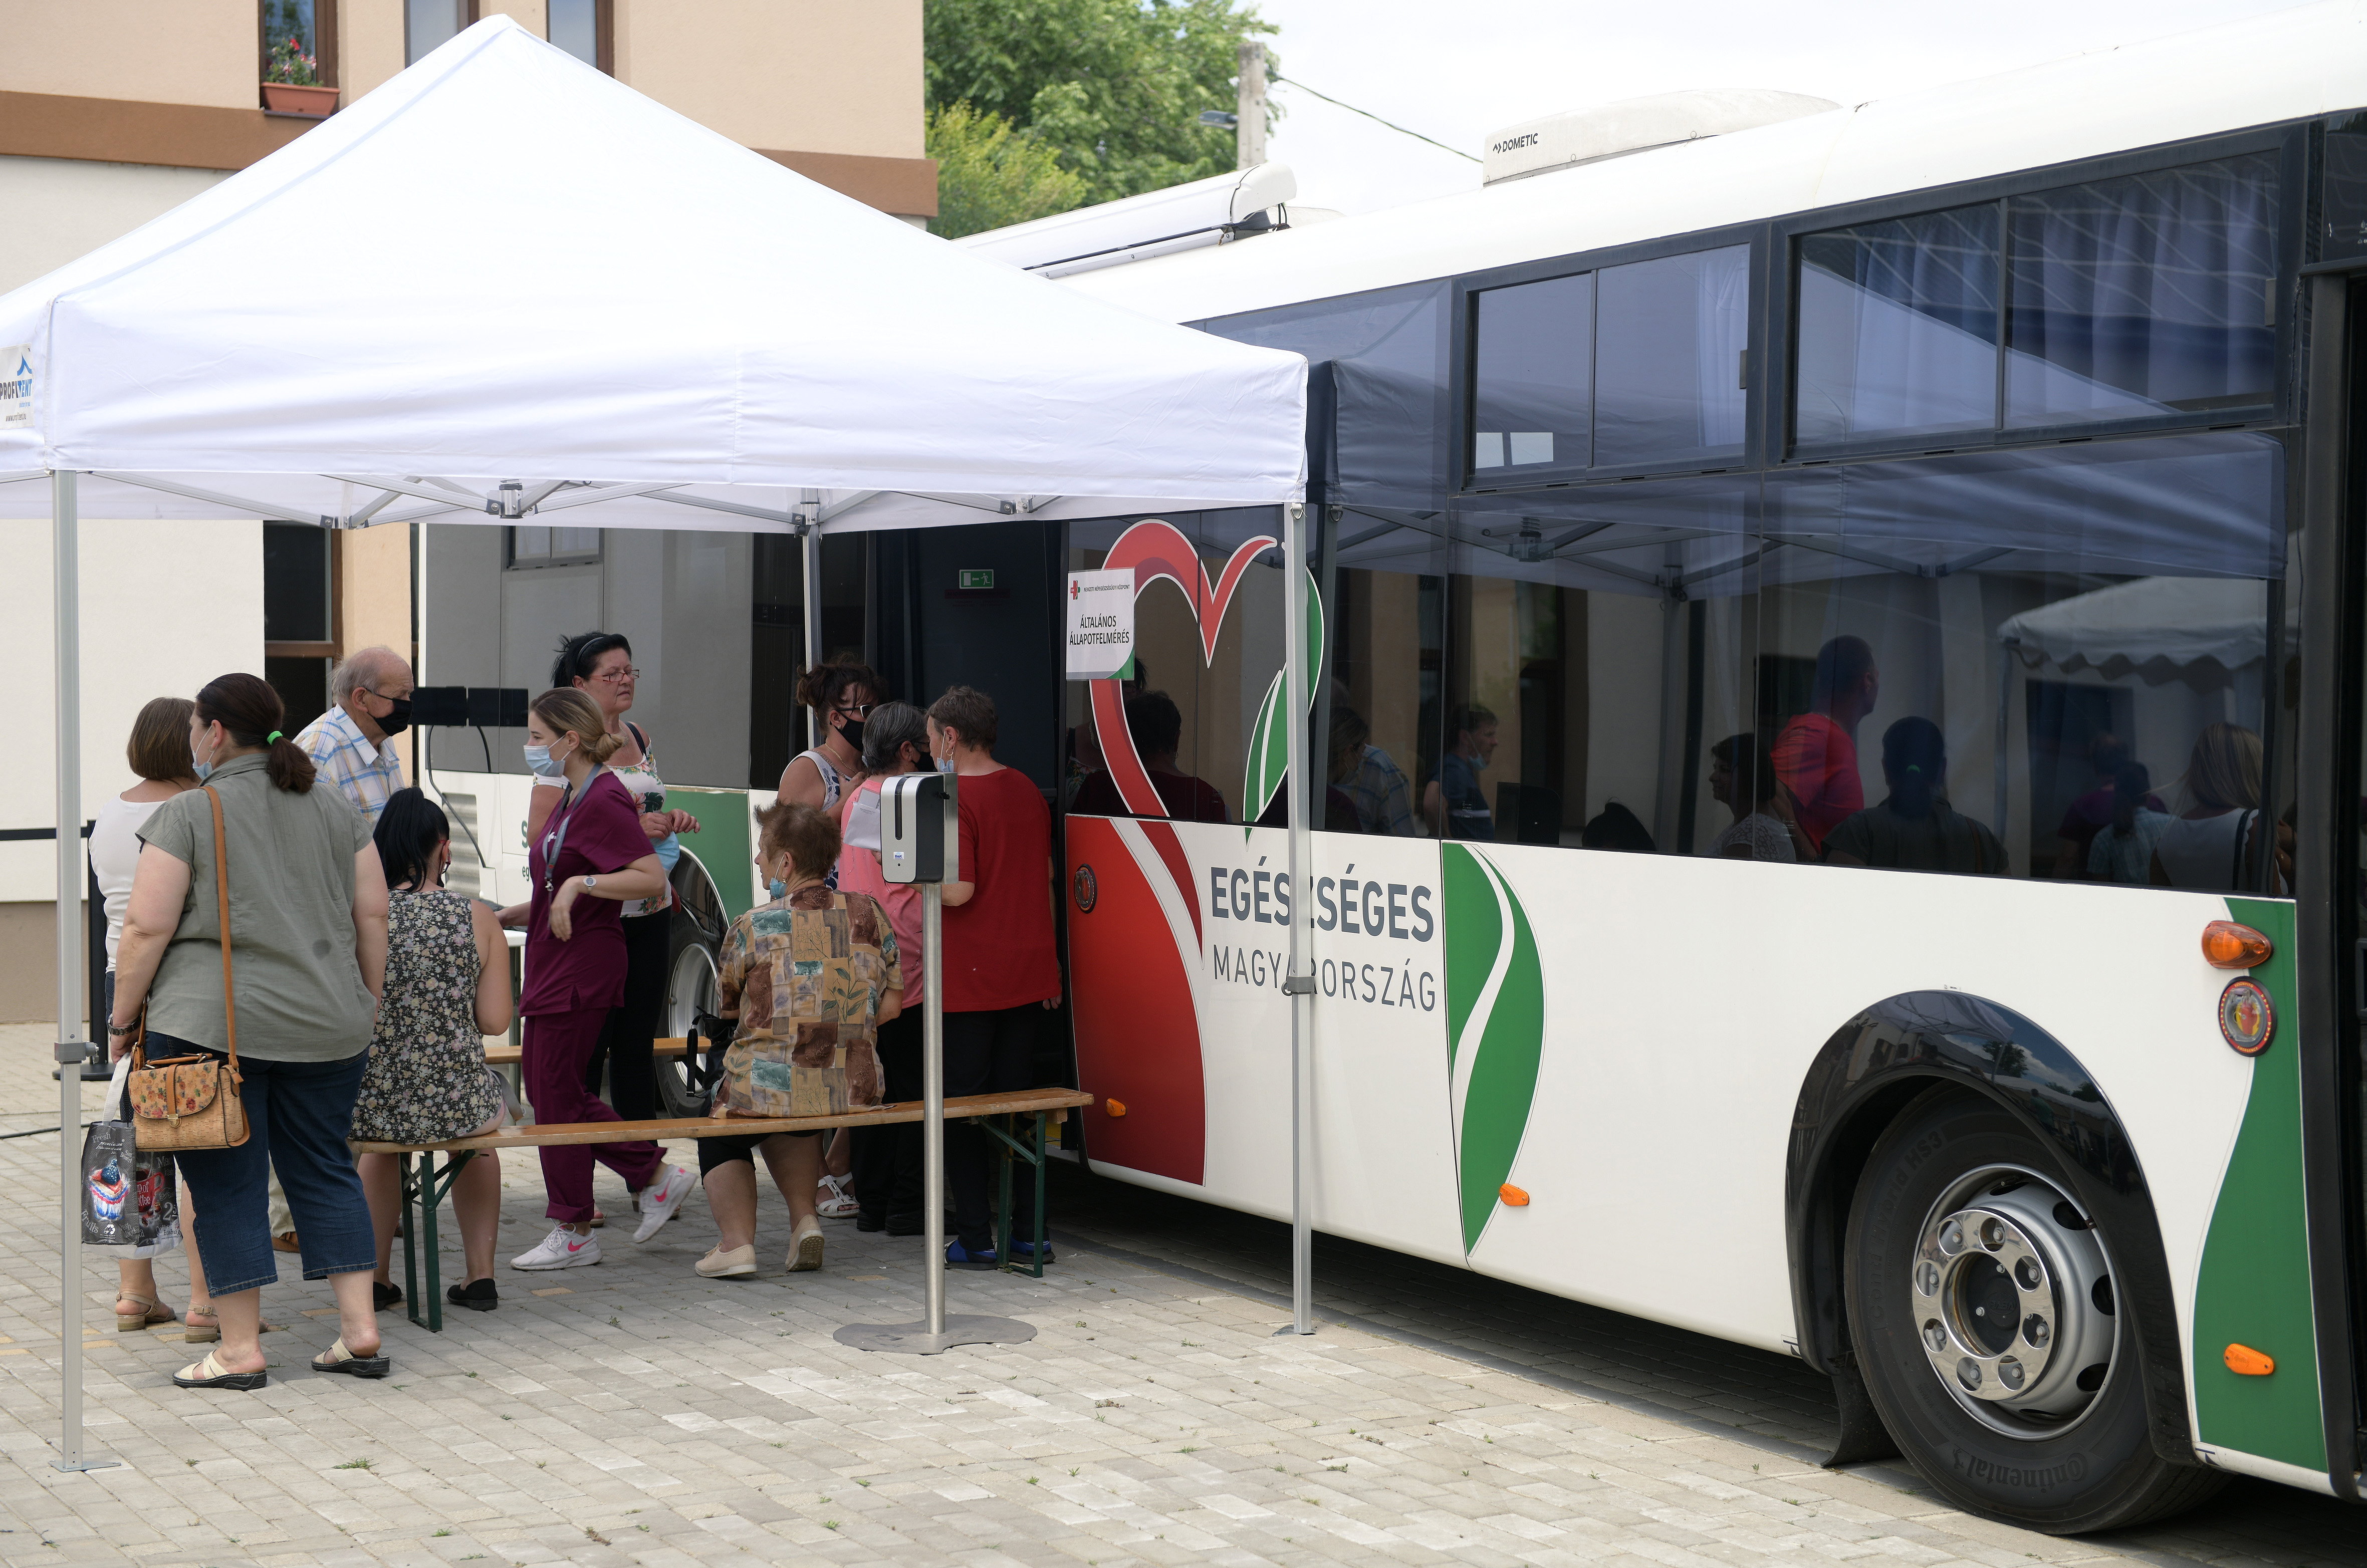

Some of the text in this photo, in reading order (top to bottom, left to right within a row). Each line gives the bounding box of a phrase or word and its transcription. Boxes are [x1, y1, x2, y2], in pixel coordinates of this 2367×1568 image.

[1503, 133, 1538, 152] DOMETIC
[1080, 613, 1116, 629] ÁLTALÁNOS
[1069, 629, 1129, 646] ÁLLAPOTFELMÉRÉS
[1211, 855, 1435, 943] EGÉSSÉGES
[1213, 944, 1436, 1012] MAGYORSZÁG
[92, 1132, 111, 1143] Fresh
[1905, 1131, 1943, 1171] HS3
[81, 1209, 99, 1233] Fruits
[1966, 1452, 2088, 1494] Continental
